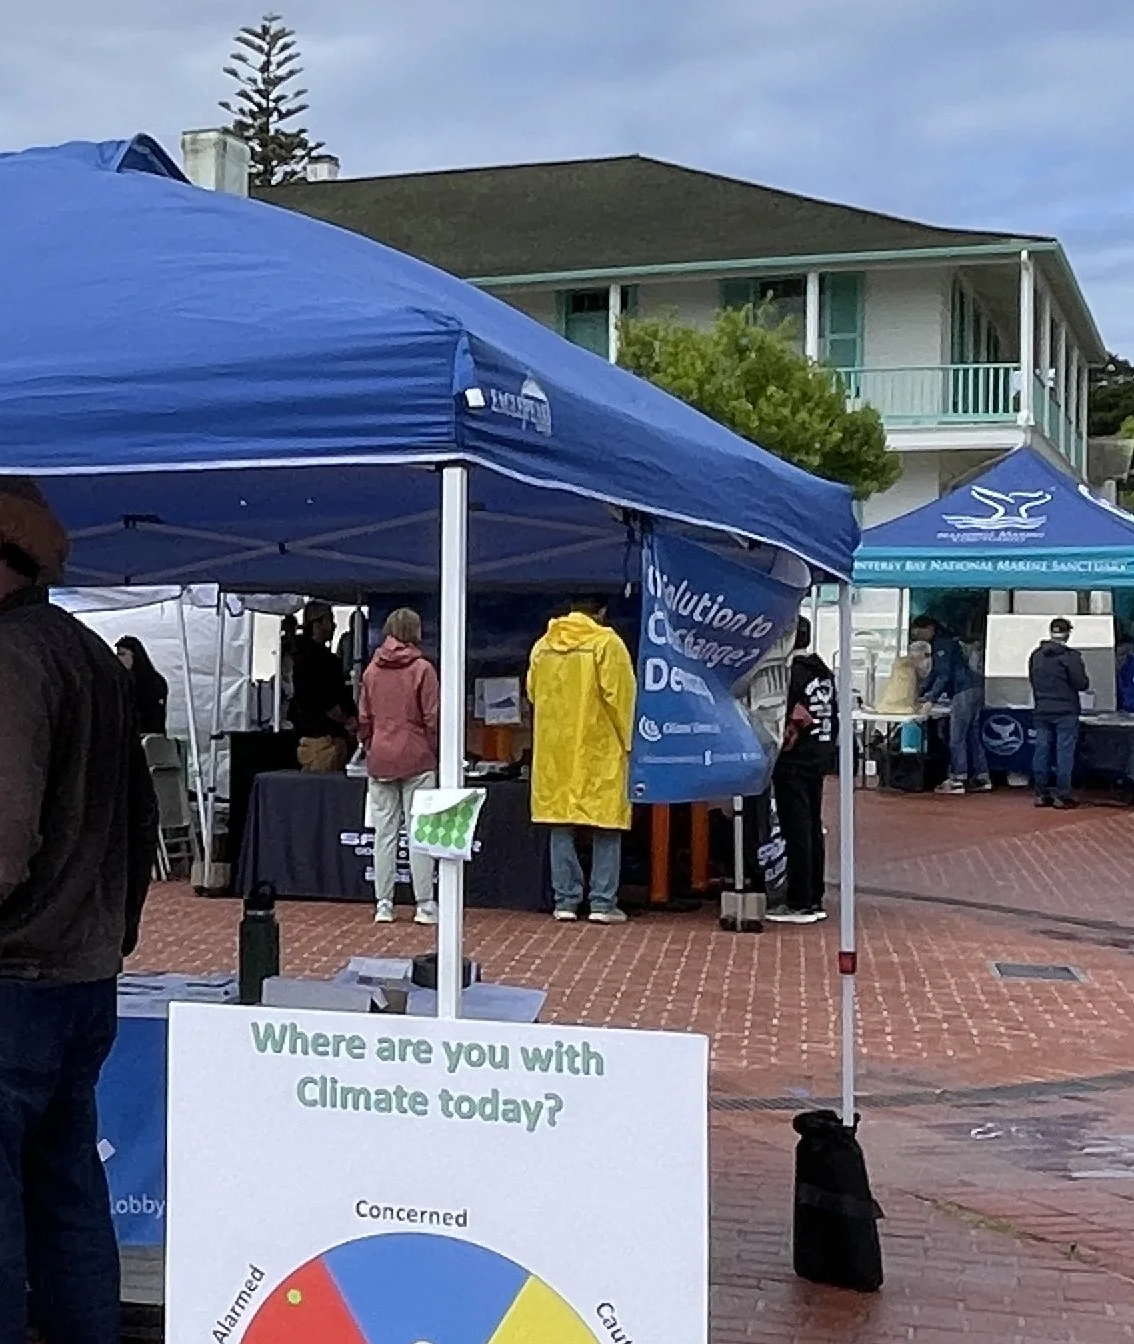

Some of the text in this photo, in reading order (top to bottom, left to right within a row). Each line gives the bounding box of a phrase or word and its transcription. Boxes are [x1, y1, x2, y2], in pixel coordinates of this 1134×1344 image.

[905, 560, 927, 571] BAY
[929, 559, 994, 571] NATIONAL
[250, 1021, 605, 1077] Where are you with
[296, 1075, 565, 1133] Climate today?
[355, 1199, 468, 1228] Concerned
